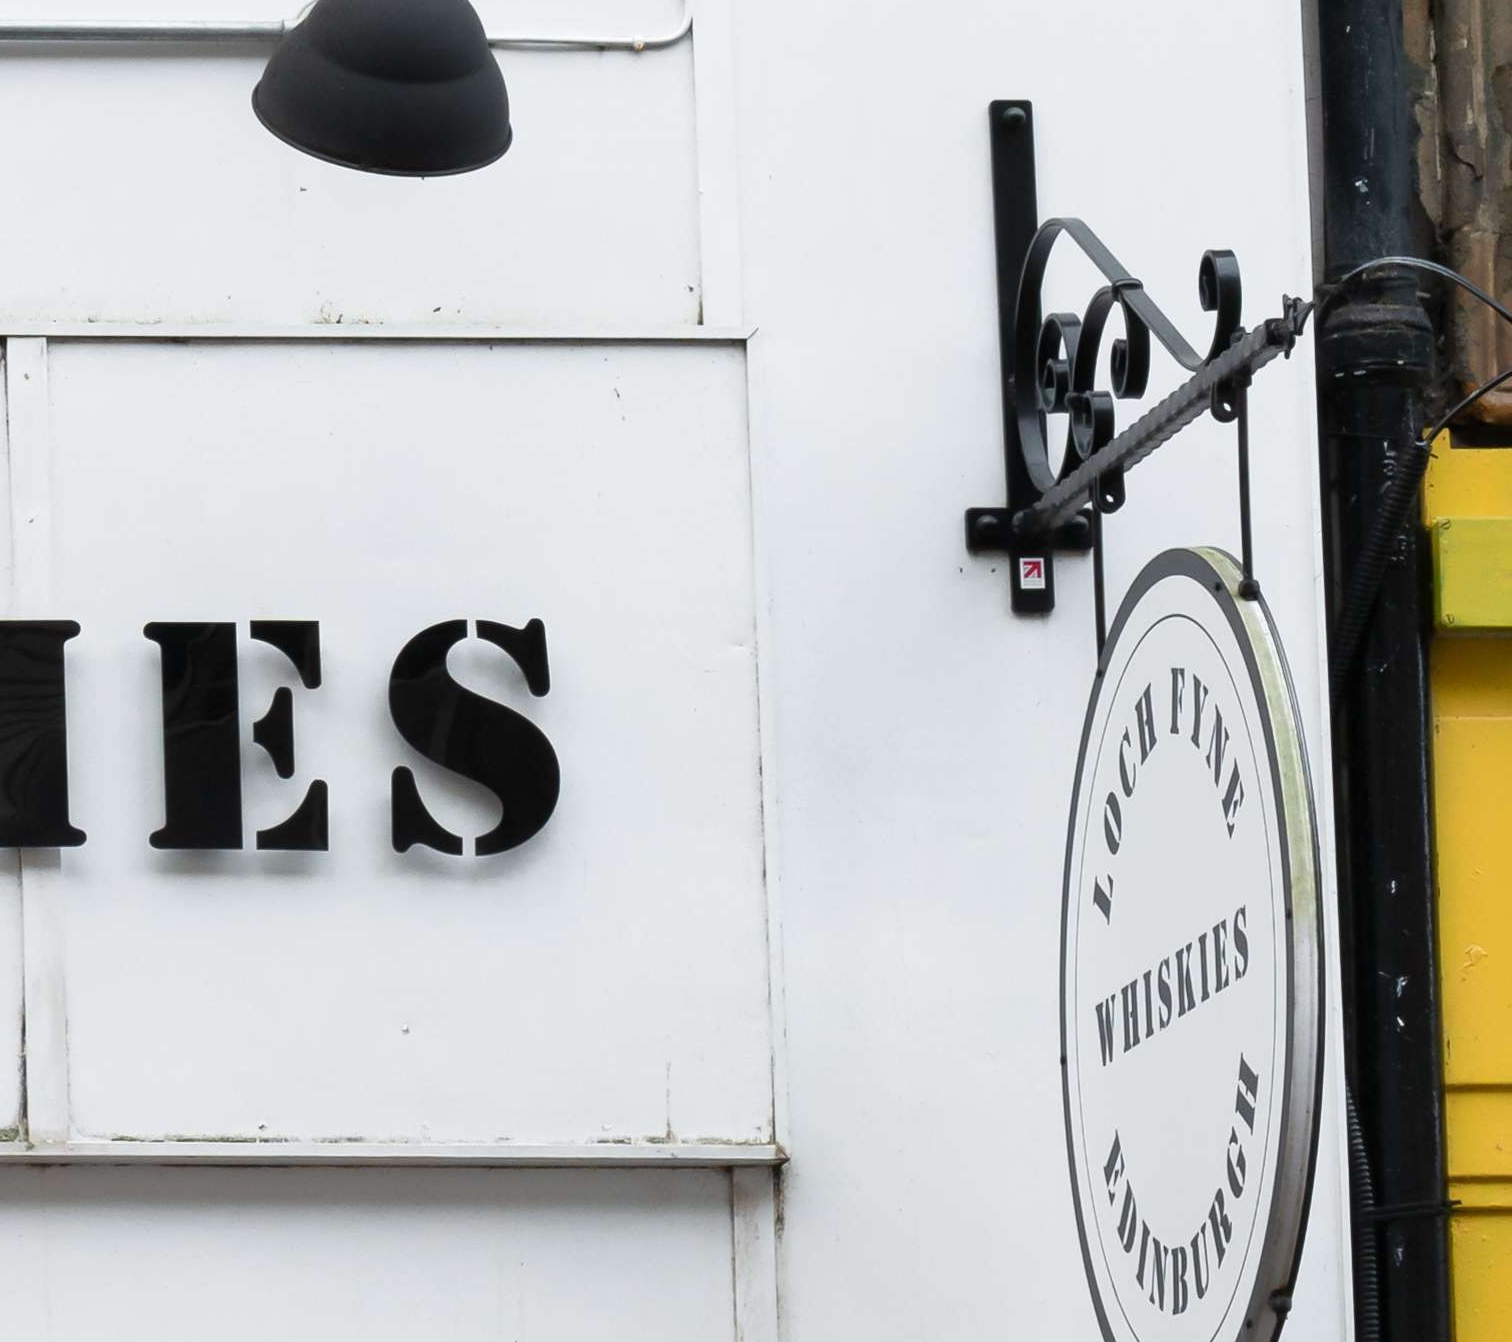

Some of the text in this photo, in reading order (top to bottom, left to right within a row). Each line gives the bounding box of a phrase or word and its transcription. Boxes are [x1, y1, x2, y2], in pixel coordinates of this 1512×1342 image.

[1091, 667, 1246, 925] LOCH FYNE
[1094, 904, 1251, 1068] WHISKIES
[1102, 1051, 1260, 1316] EDINBURGH
